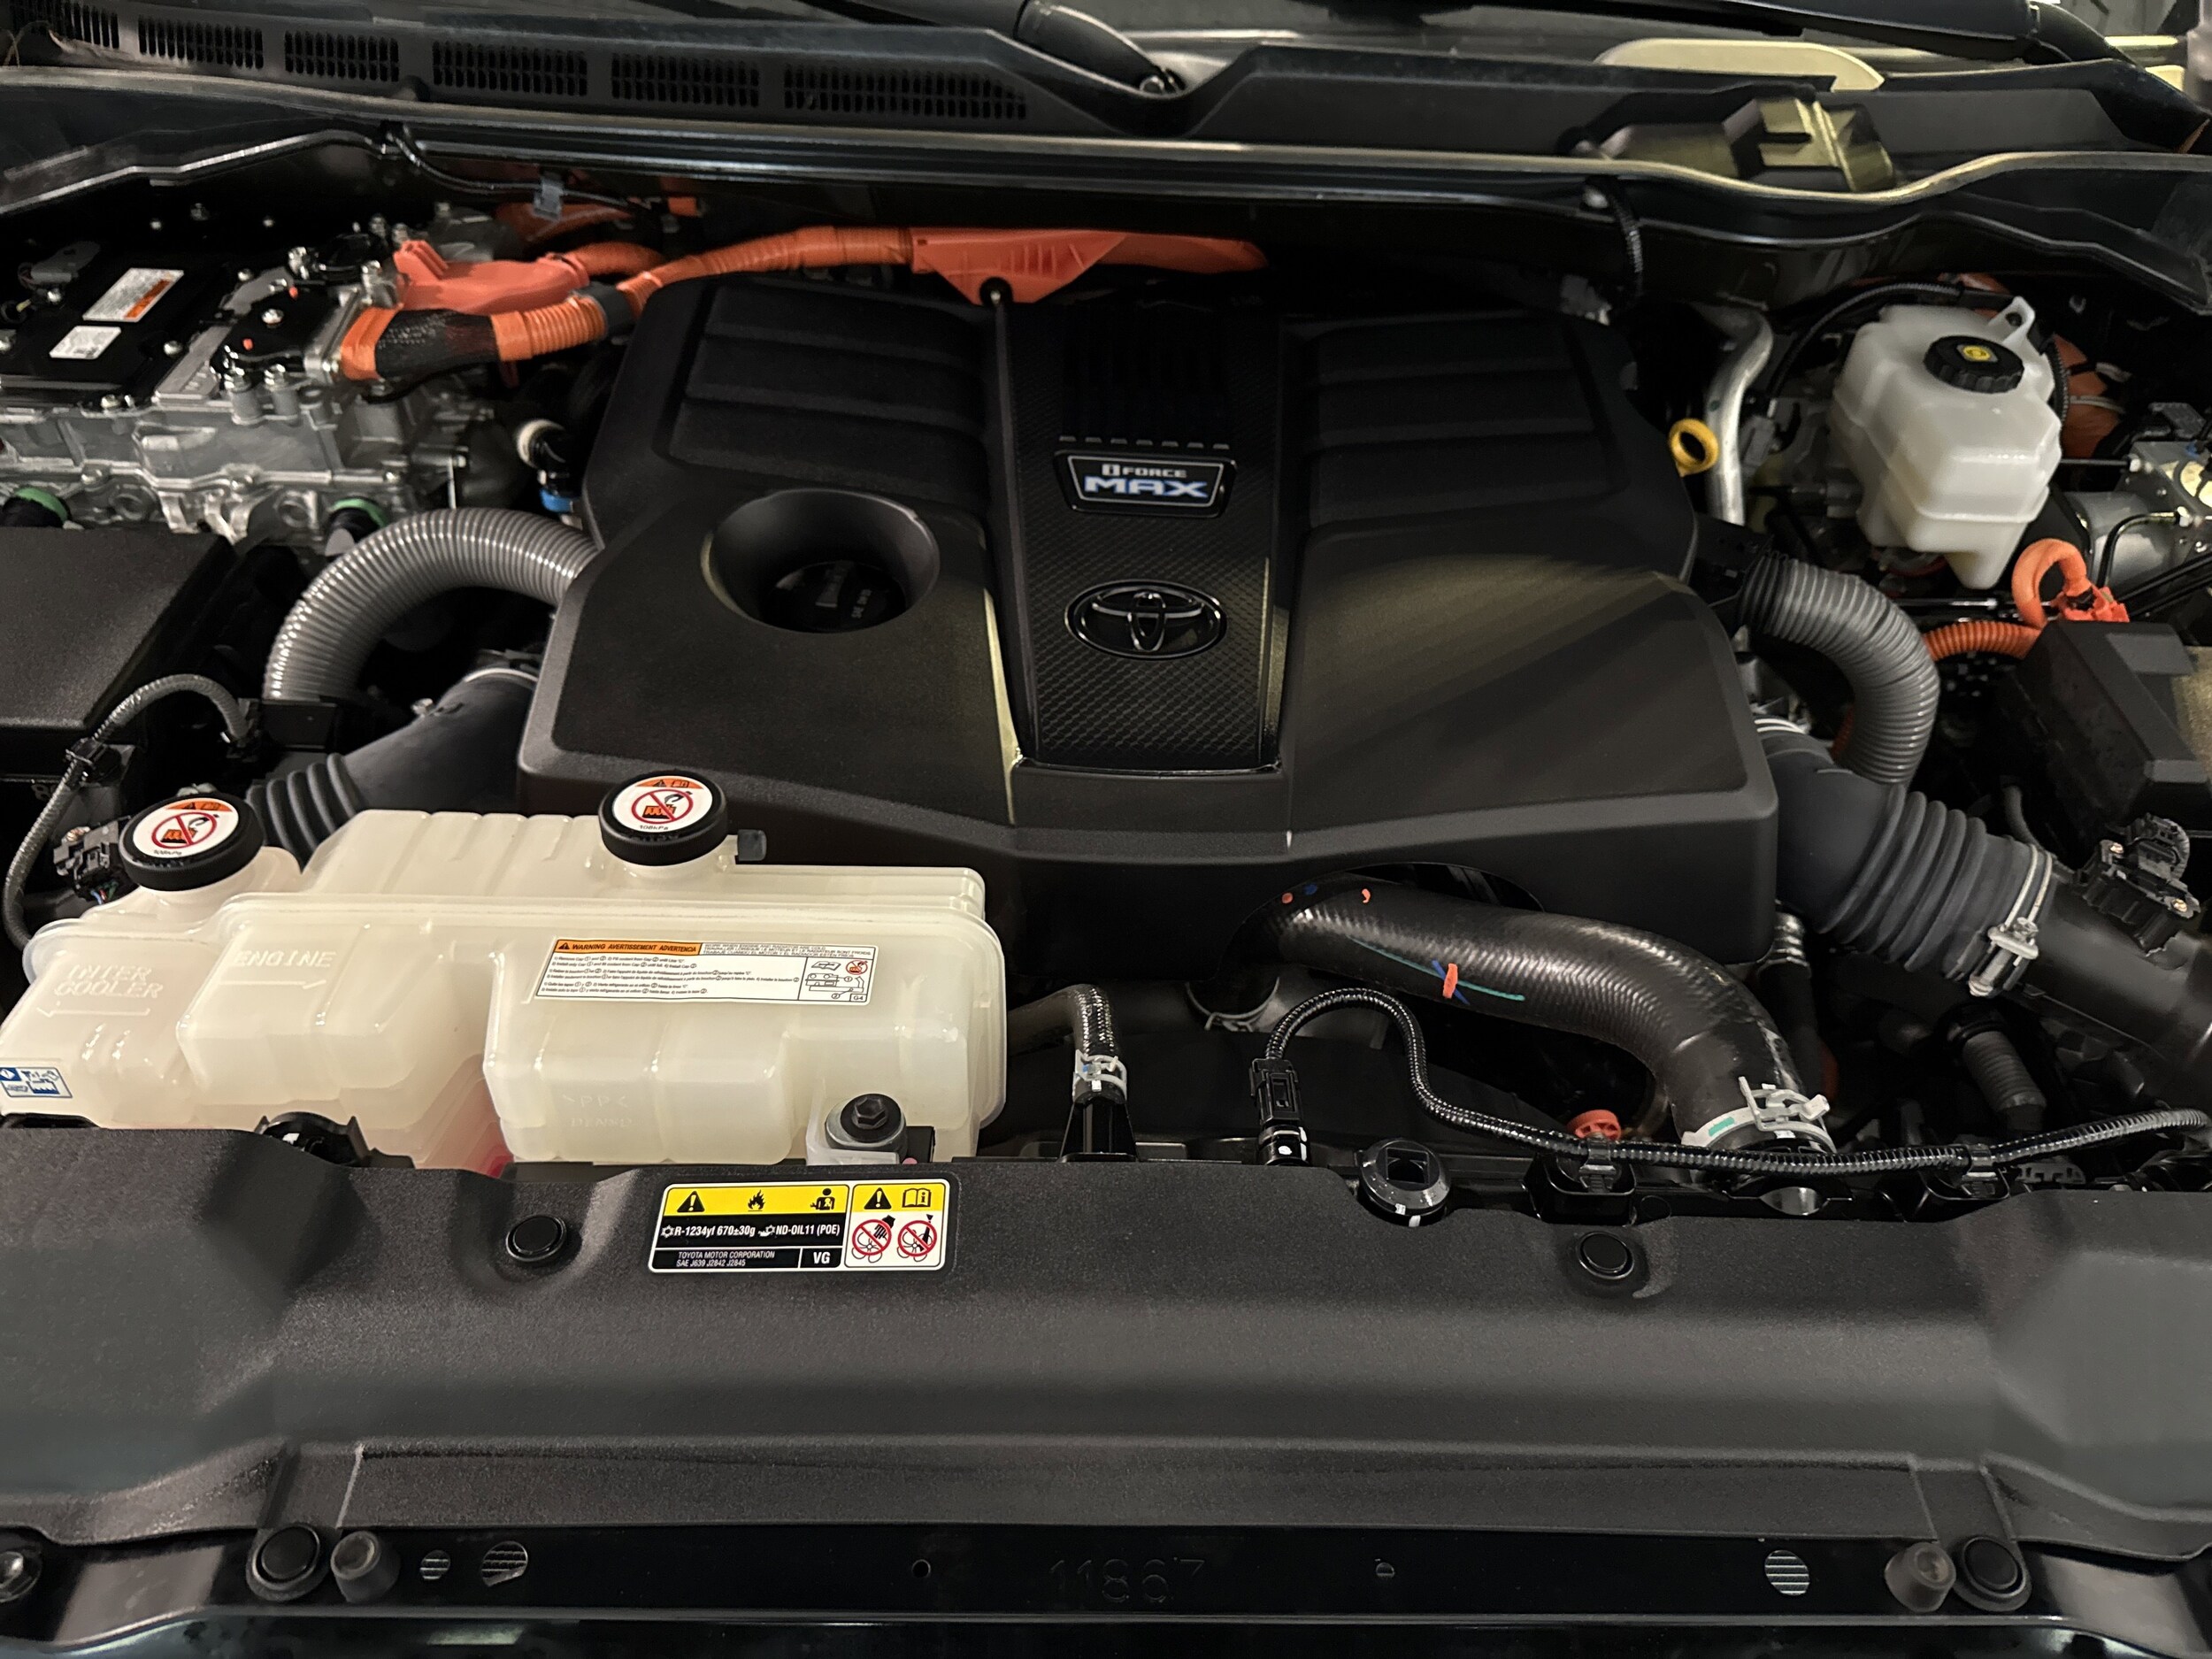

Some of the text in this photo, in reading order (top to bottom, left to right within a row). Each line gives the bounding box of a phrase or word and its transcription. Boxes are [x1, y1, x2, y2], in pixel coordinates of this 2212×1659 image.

[1084, 475, 1209, 498] MAX
[233, 949, 337, 969] ENGINE
[65, 964, 152, 981] INTER
[53, 980, 165, 999] COOLER
[673, 1224, 841, 1238] R-1234yf 670±30g ND-OIL11 (POE)
[678, 1251, 703, 1260] TOYOTA
[729, 1250, 776, 1259] CORPORATION
[812, 1251, 832, 1265] VG
[676, 1258, 746, 1268] SAE J639 J2842 J2845
